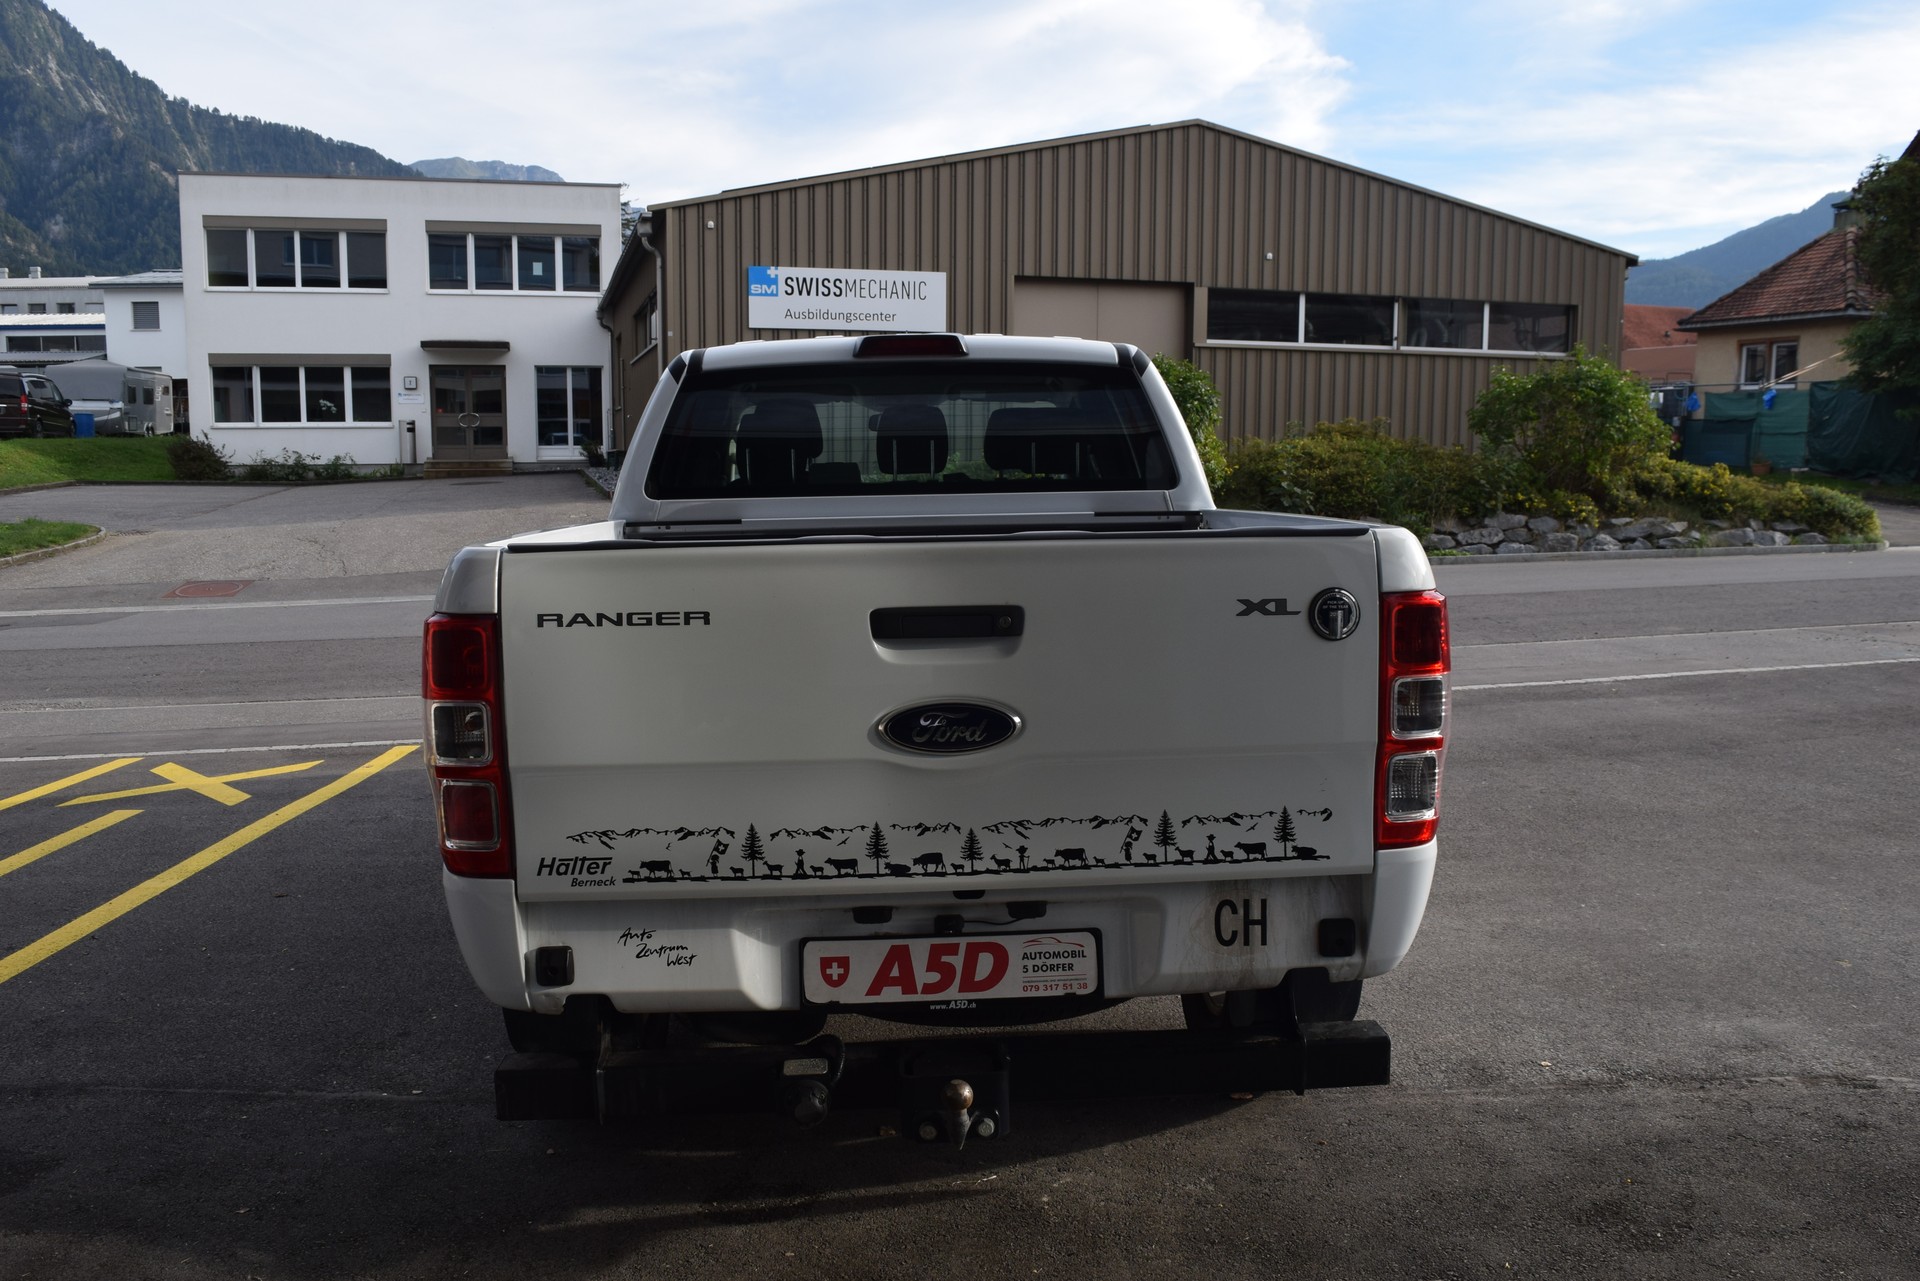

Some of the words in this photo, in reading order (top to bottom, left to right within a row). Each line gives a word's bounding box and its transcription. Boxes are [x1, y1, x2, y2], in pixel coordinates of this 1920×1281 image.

[750, 284, 777, 295] SM
[784, 276, 927, 301] SWISSMECHANIC
[784, 308, 897, 323] Ausbildungscenter
[1235, 598, 1302, 616] XL
[537, 611, 711, 628] RANGER
[912, 712, 987, 743] Ford
[571, 876, 616, 888] Berneck
[1214, 898, 1268, 947] CH
[617, 927, 656, 946] Auto
[635, 942, 689, 959] Zentrum
[1021, 949, 1087, 961] AUTOMOBIL
[666, 953, 697, 967] West
[1022, 964, 1029, 974] 5
[1032, 961, 1074, 973] DÖRFER
[864, 941, 1009, 997] A5D
[1022, 984, 1040, 992] 079
[1042, 984, 1060, 992] 317
[930, 1000, 977, 1010] www.A5D.ch
